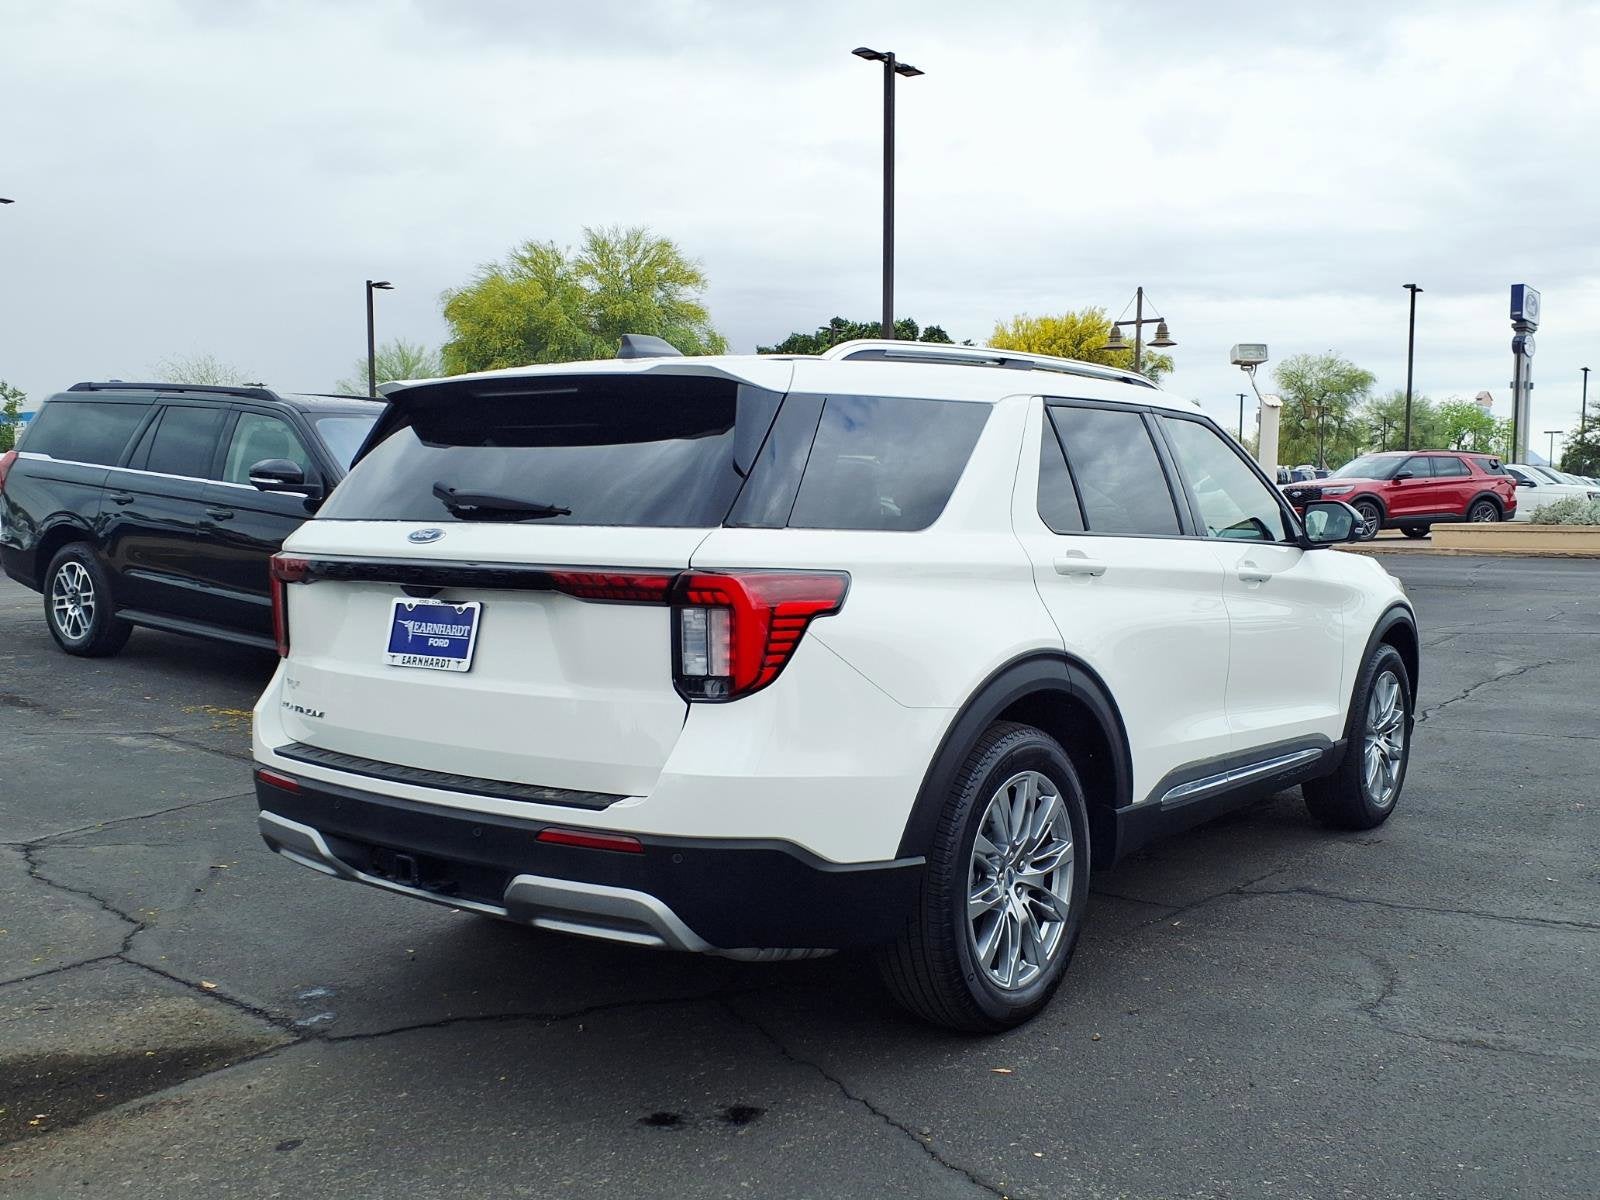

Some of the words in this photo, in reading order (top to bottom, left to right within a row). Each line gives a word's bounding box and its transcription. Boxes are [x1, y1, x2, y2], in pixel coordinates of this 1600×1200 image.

[413, 621, 470, 637] EARNHARDT
[428, 638, 450, 647] FORD
[402, 655, 452, 669] EARNHARDT
